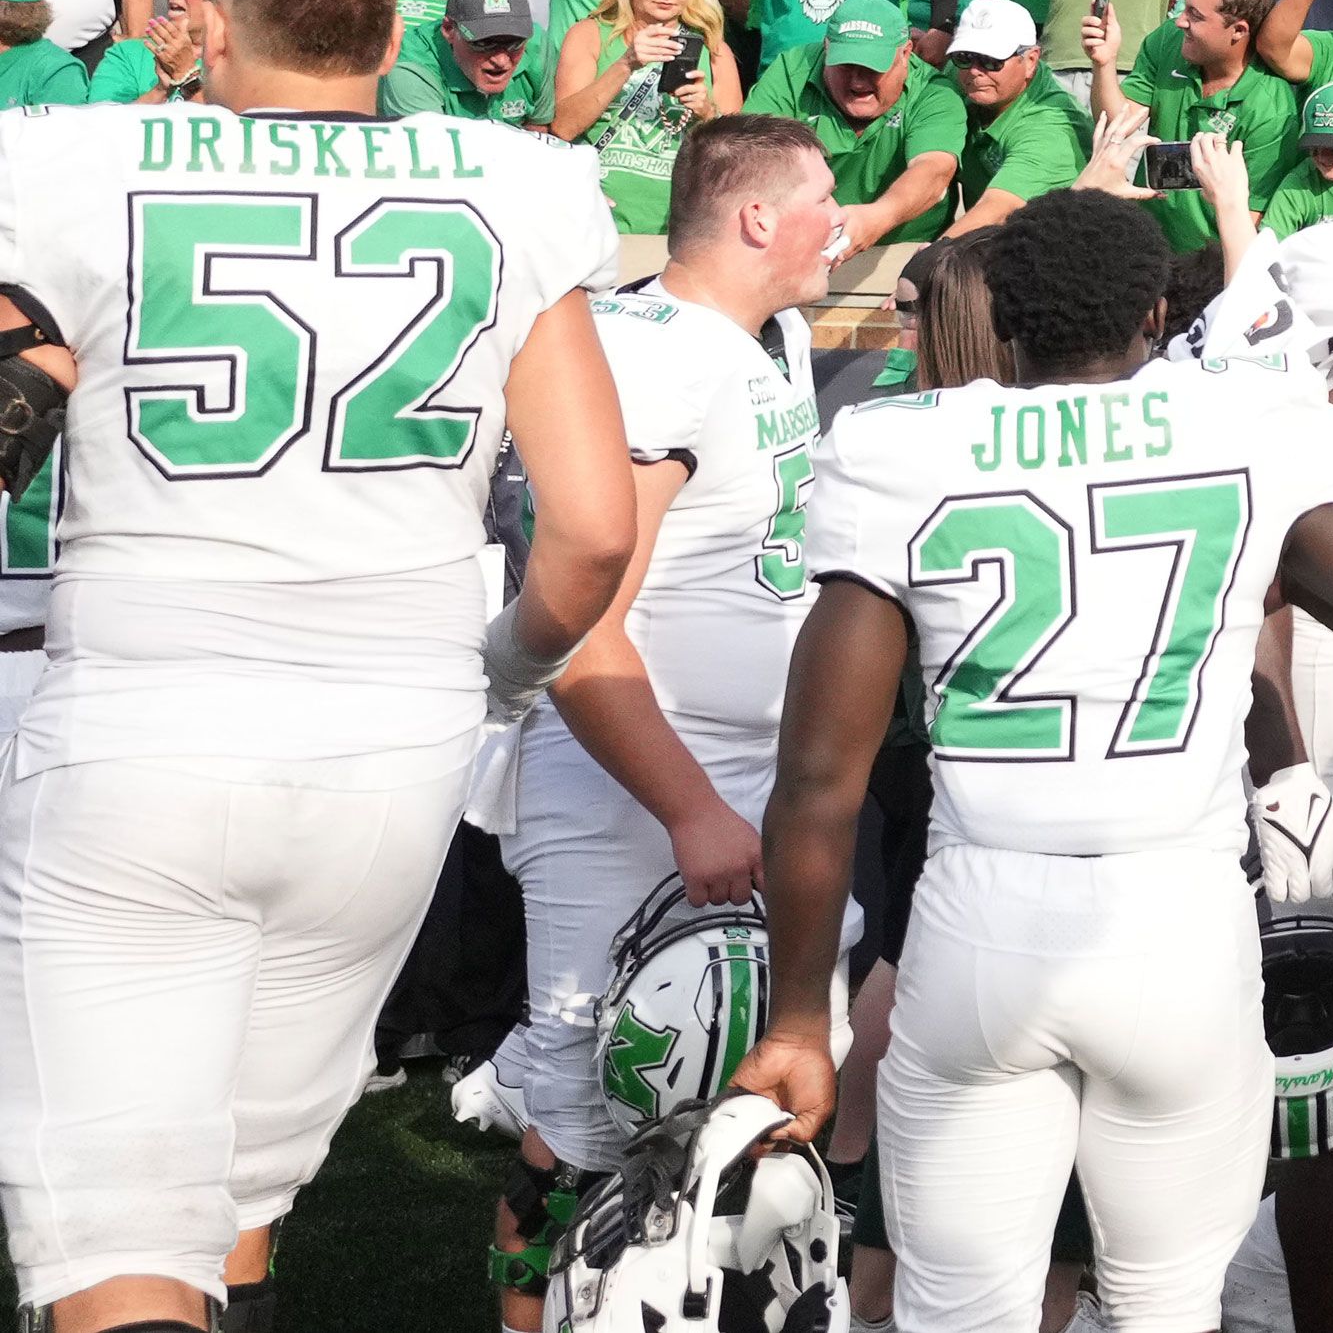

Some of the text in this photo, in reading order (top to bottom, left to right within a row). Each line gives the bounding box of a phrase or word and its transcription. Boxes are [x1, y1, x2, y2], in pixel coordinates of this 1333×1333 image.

[839, 20, 884, 37] MARSHALL
[846, 32, 875, 40] FOOTBALL
[627, 71, 658, 112] GO HERD
[138, 117, 485, 179] DRISKELL
[599, 132, 613, 148] GO
[123, 191, 505, 482] 52
[971, 390, 1174, 472] JONES
[908, 467, 1252, 763] 27
